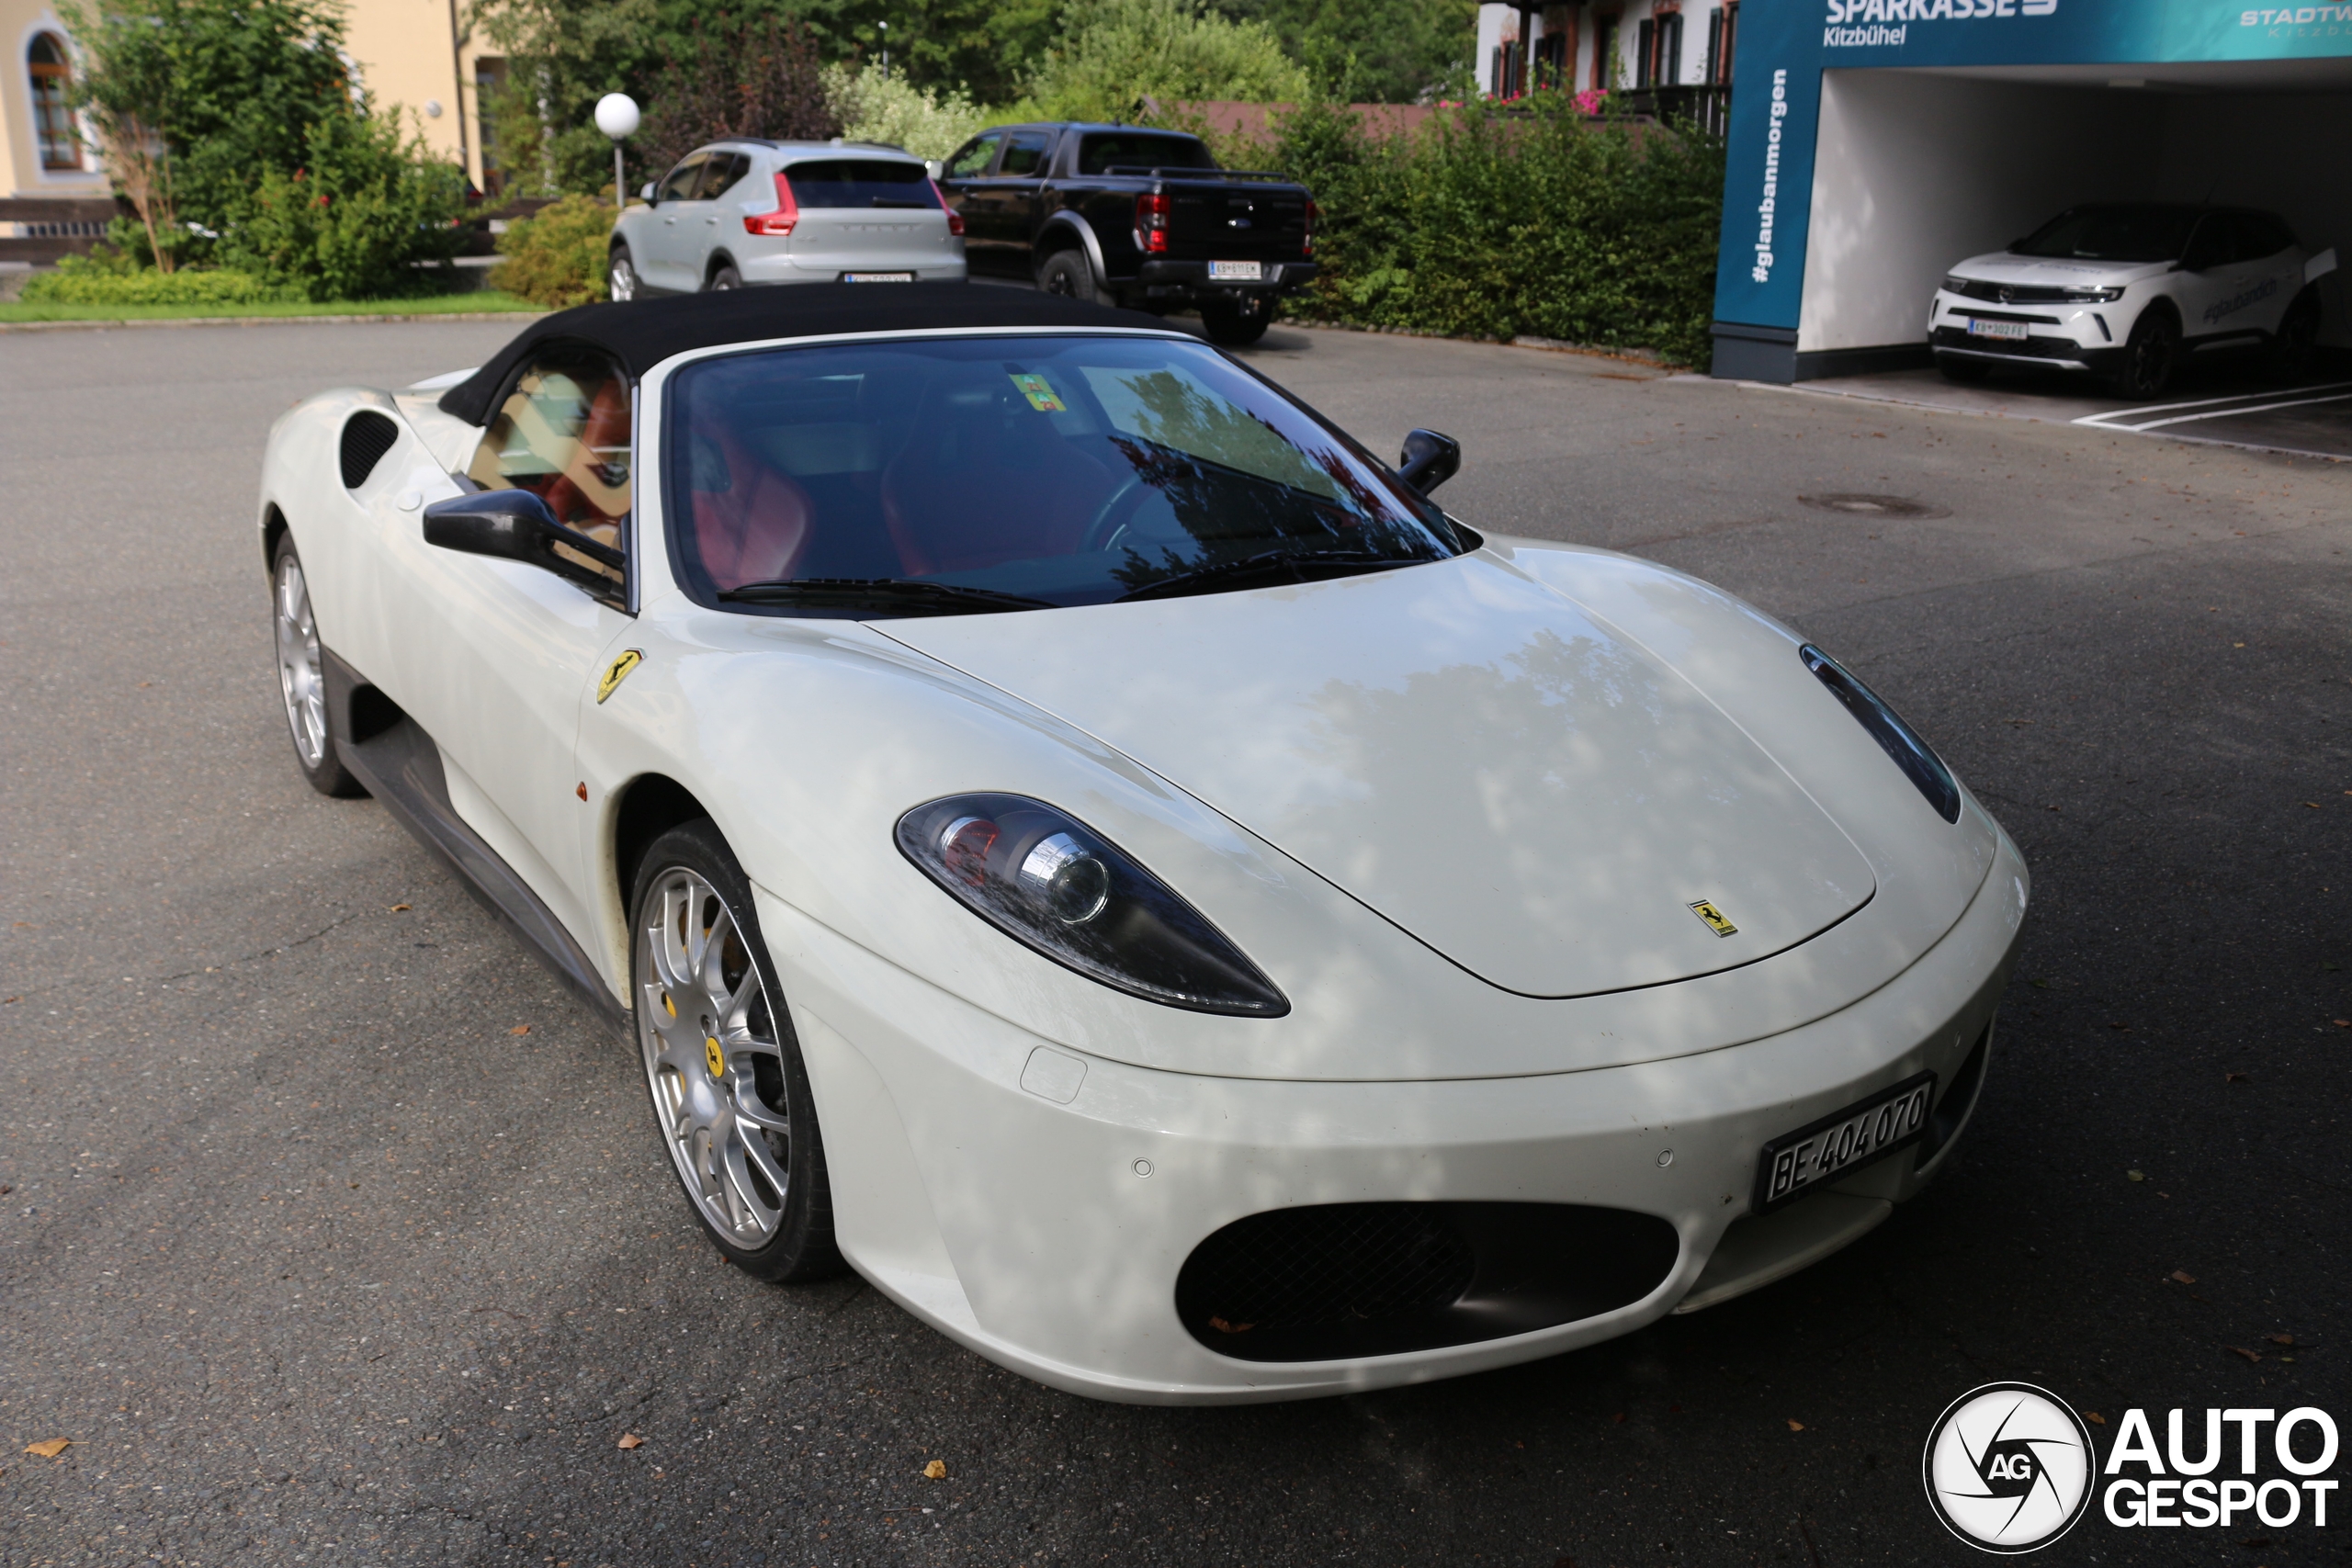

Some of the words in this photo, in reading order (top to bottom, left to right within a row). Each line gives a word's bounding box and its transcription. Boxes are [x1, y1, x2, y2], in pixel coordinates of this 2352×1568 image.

[1826, 0, 2017, 23] SPARKASSE
[1823, 24, 1906, 47] Kitzbühel
[1752, 69, 1788, 283] #glaubanmorgen
[2202, 277, 2278, 324] #glaubandich
